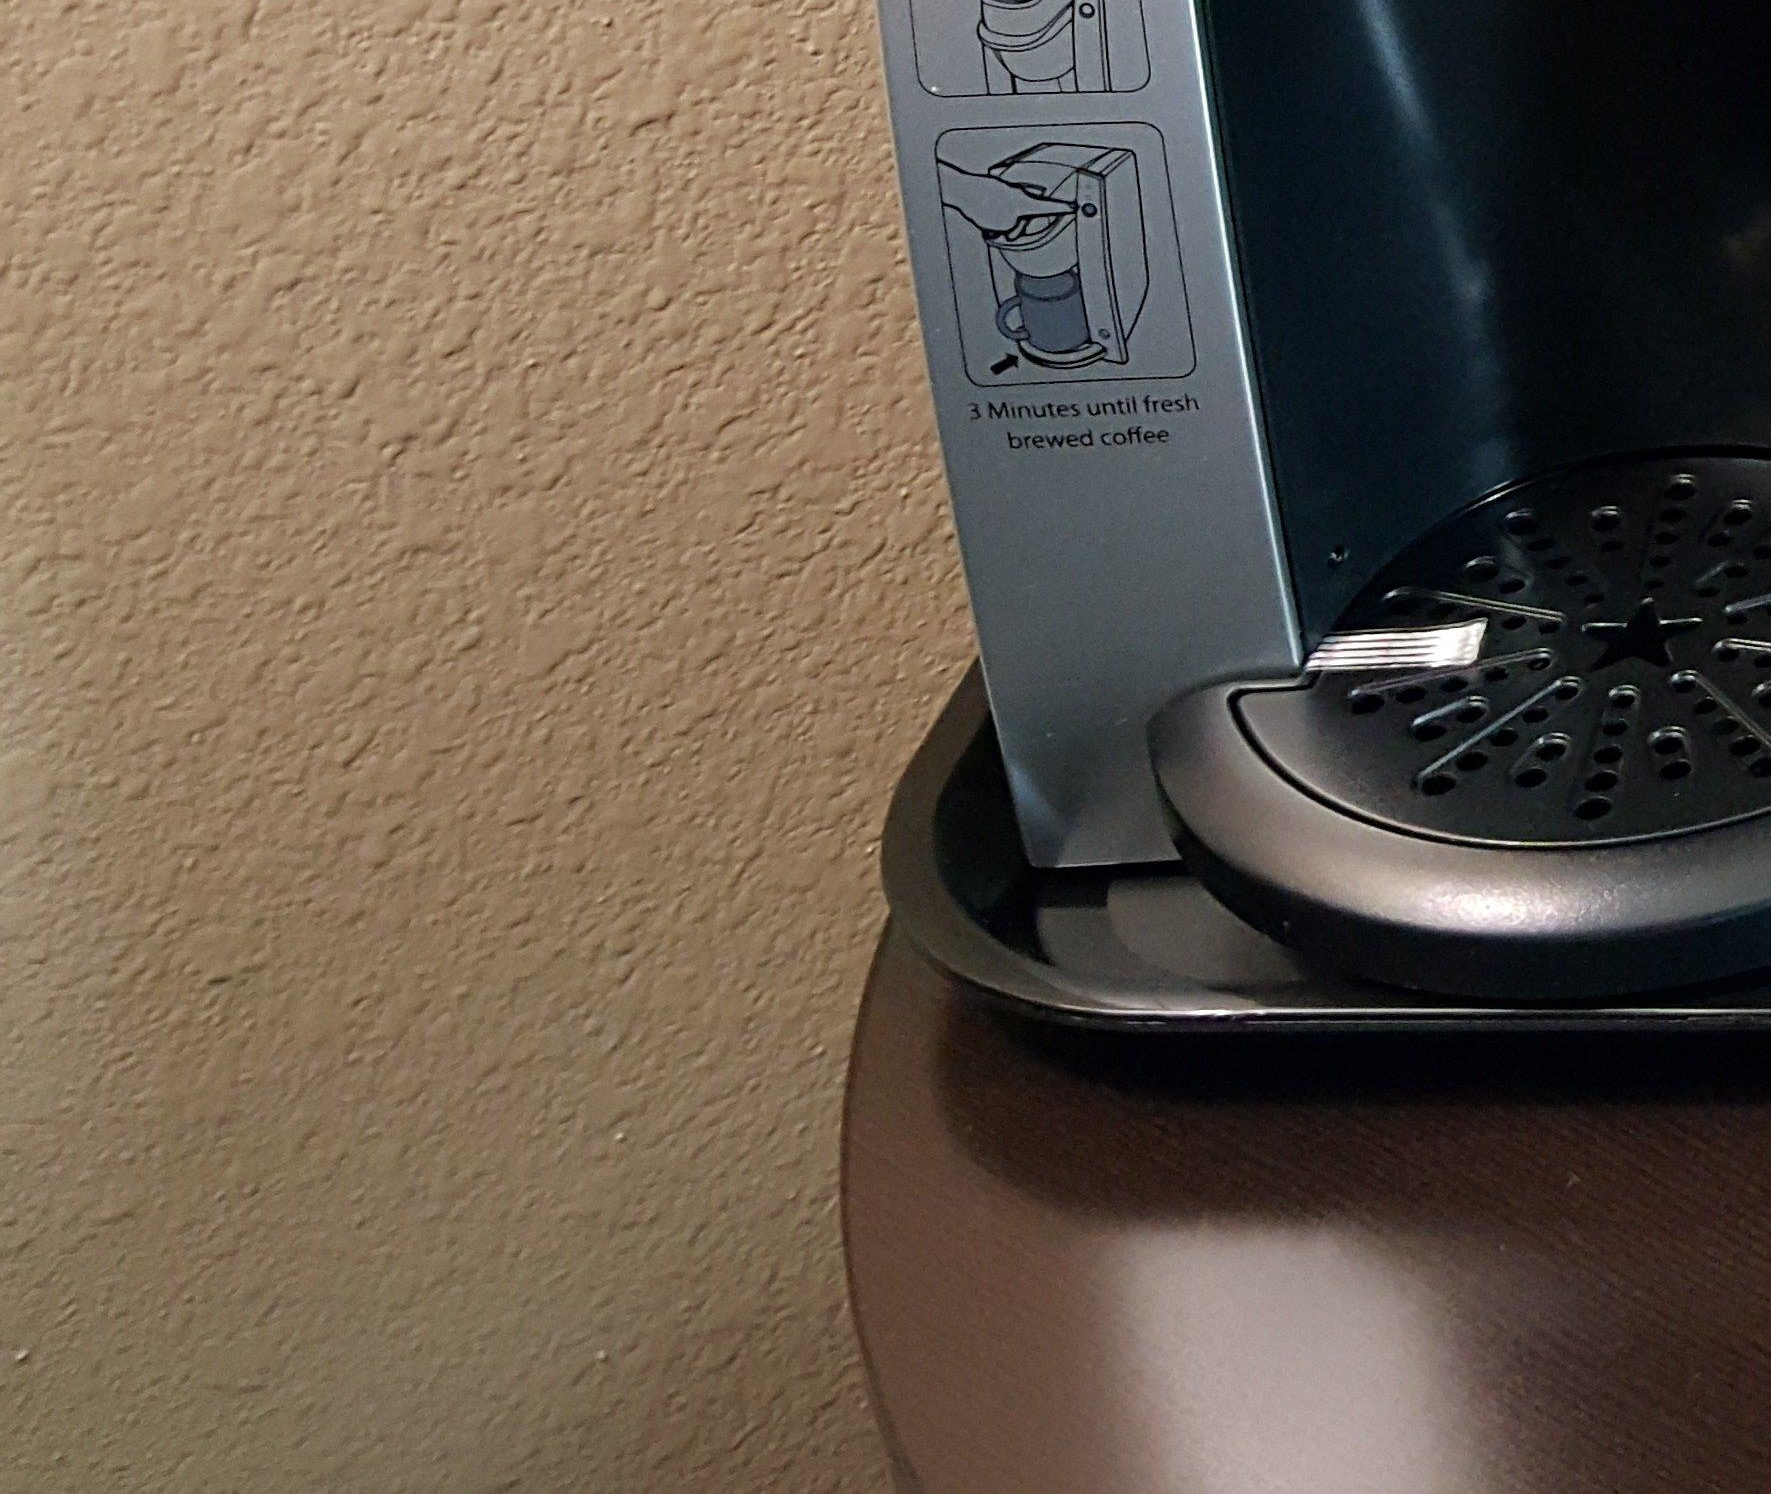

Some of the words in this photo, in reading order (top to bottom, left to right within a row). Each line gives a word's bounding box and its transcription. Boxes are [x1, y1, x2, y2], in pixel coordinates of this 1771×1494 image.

[970, 402, 982, 421] 3
[988, 399, 1081, 420] Minutes
[1087, 396, 1137, 416] until
[1142, 393, 1200, 414] fresh
[1007, 428, 1094, 449] brewed
[1100, 426, 1170, 447] coffee
